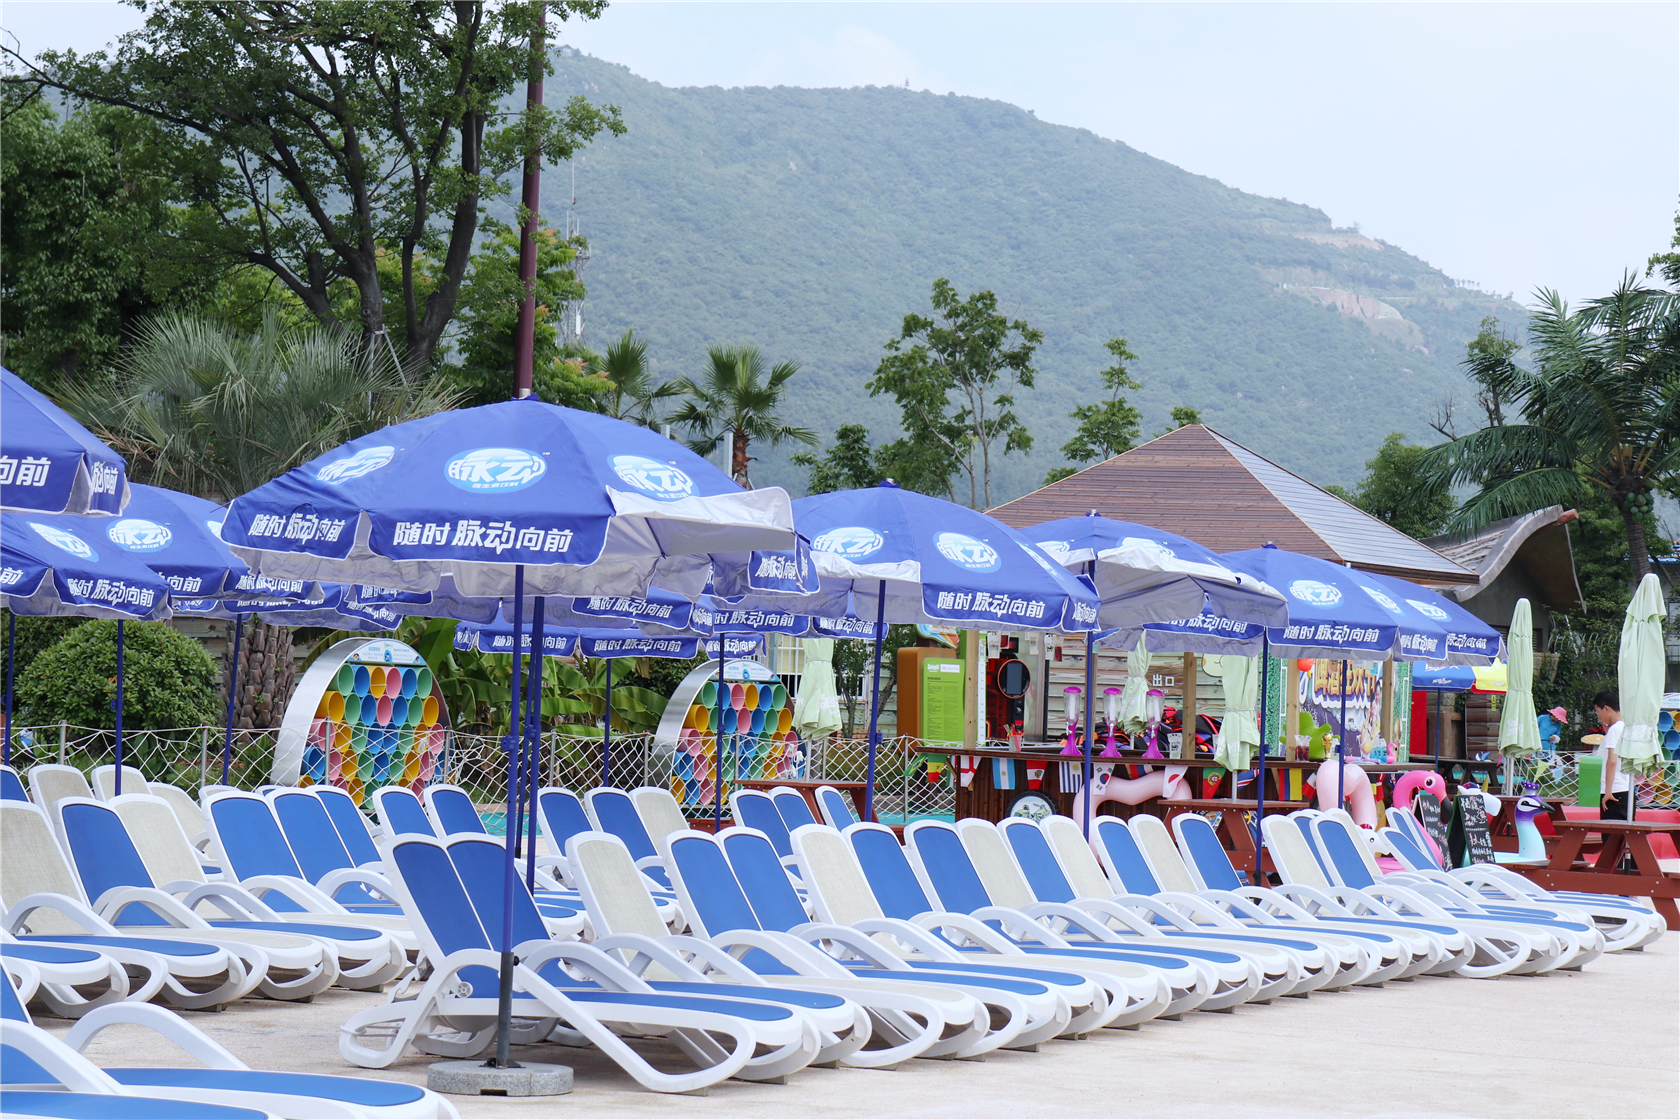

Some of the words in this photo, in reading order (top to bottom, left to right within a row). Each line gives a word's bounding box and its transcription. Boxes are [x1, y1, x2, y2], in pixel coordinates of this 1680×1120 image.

[448, 448, 546, 484] 脉动
[247, 513, 345, 544] 随时脉动向前
[393, 519, 574, 555] 随时脉动向前
[0, 566, 23, 585] 前
[157, 571, 203, 592] 向前
[67, 578, 155, 607] 随时脉动向前
[587, 597, 673, 618] 随时脉动向前
[937, 591, 1045, 619] 随时脉动向前
[1283, 624, 1380, 645] 随时脉动向前
[594, 639, 682, 653] 随时脉动向前
[1152, 673, 1175, 687] 出口
